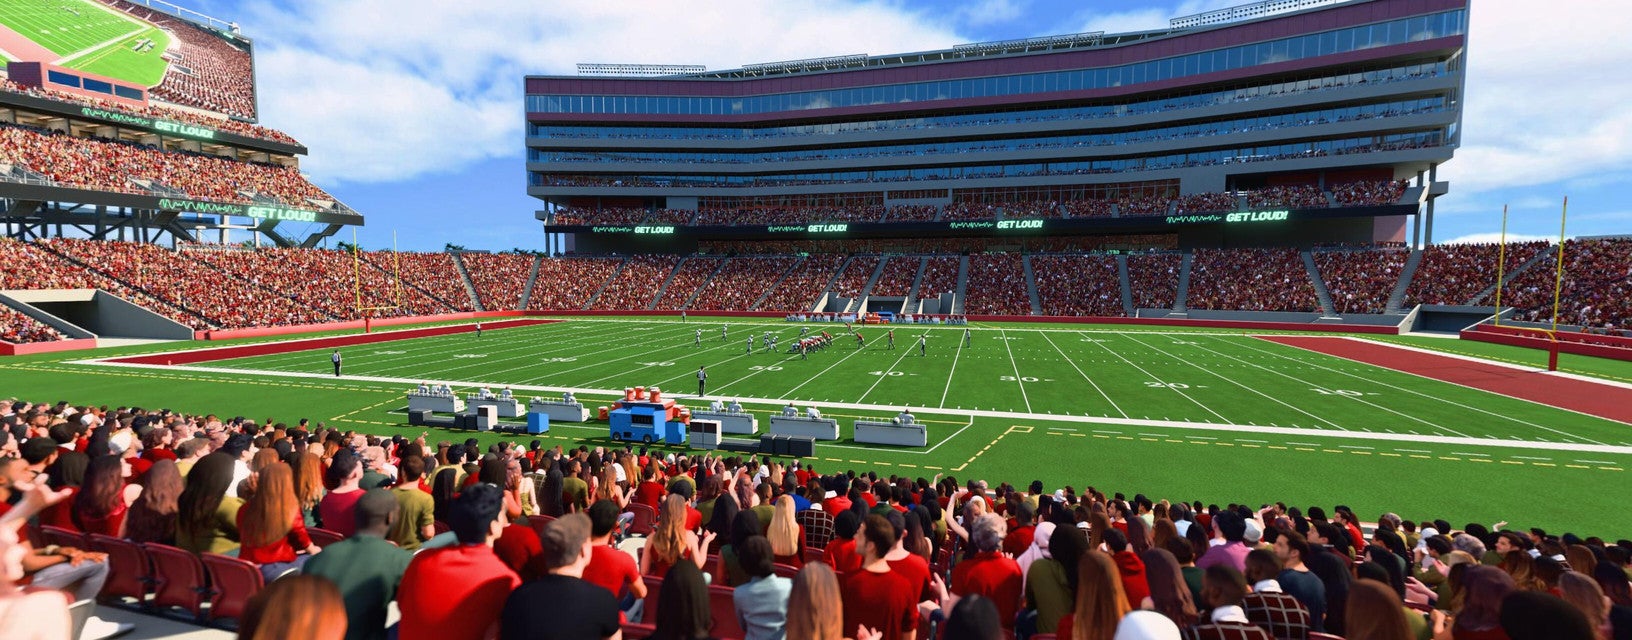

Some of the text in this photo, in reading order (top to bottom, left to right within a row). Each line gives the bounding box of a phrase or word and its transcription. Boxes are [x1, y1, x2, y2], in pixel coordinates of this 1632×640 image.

[155, 121, 214, 138] GET LOUD!
[248, 206, 316, 222] GET LOUD!
[1226, 210, 1289, 222] GET LOUD!
[808, 224, 847, 232] GET LOUD!
[997, 220, 1043, 229] GET LOUD!
[634, 226, 674, 234] GET LOUD!
[1143, 381, 1190, 389] 20
